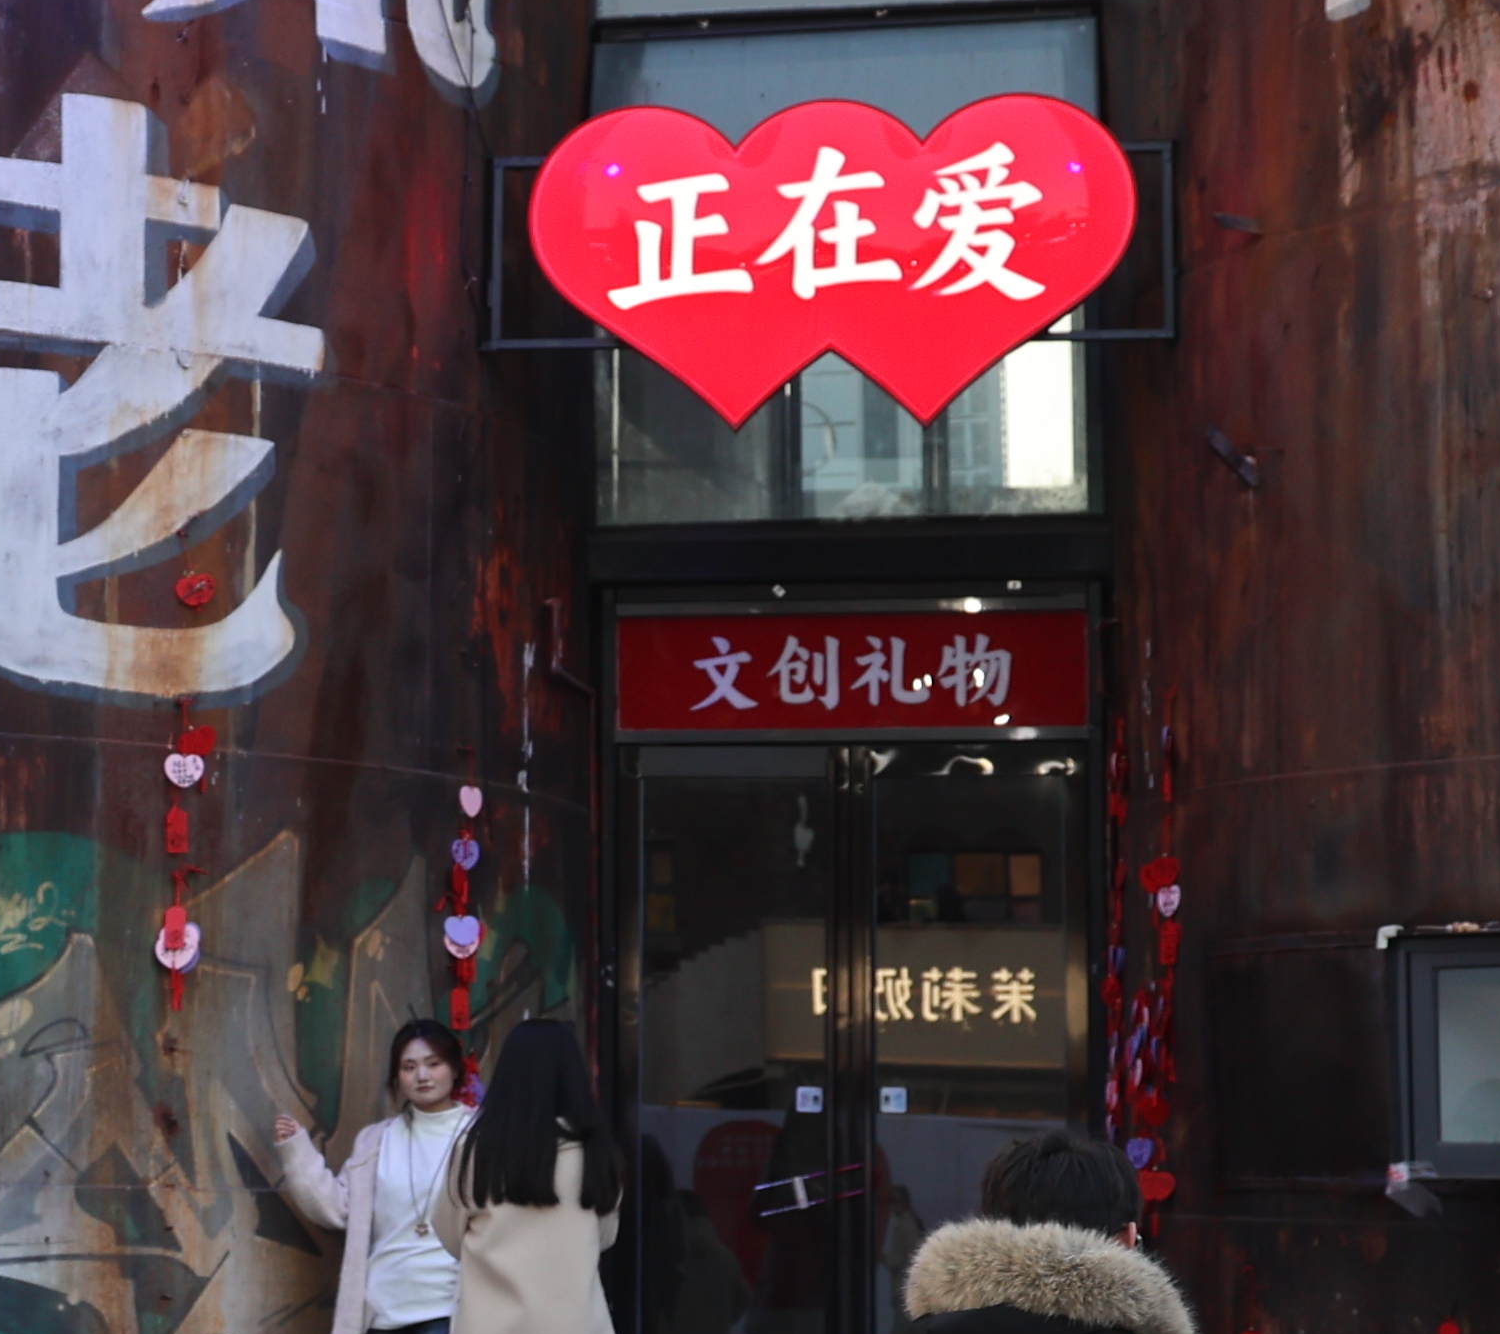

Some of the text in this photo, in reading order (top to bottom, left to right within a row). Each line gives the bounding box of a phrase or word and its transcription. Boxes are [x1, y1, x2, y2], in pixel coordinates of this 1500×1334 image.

[605, 141, 1046, 310] 正在爱
[689, 632, 1013, 712] 文创礼物
